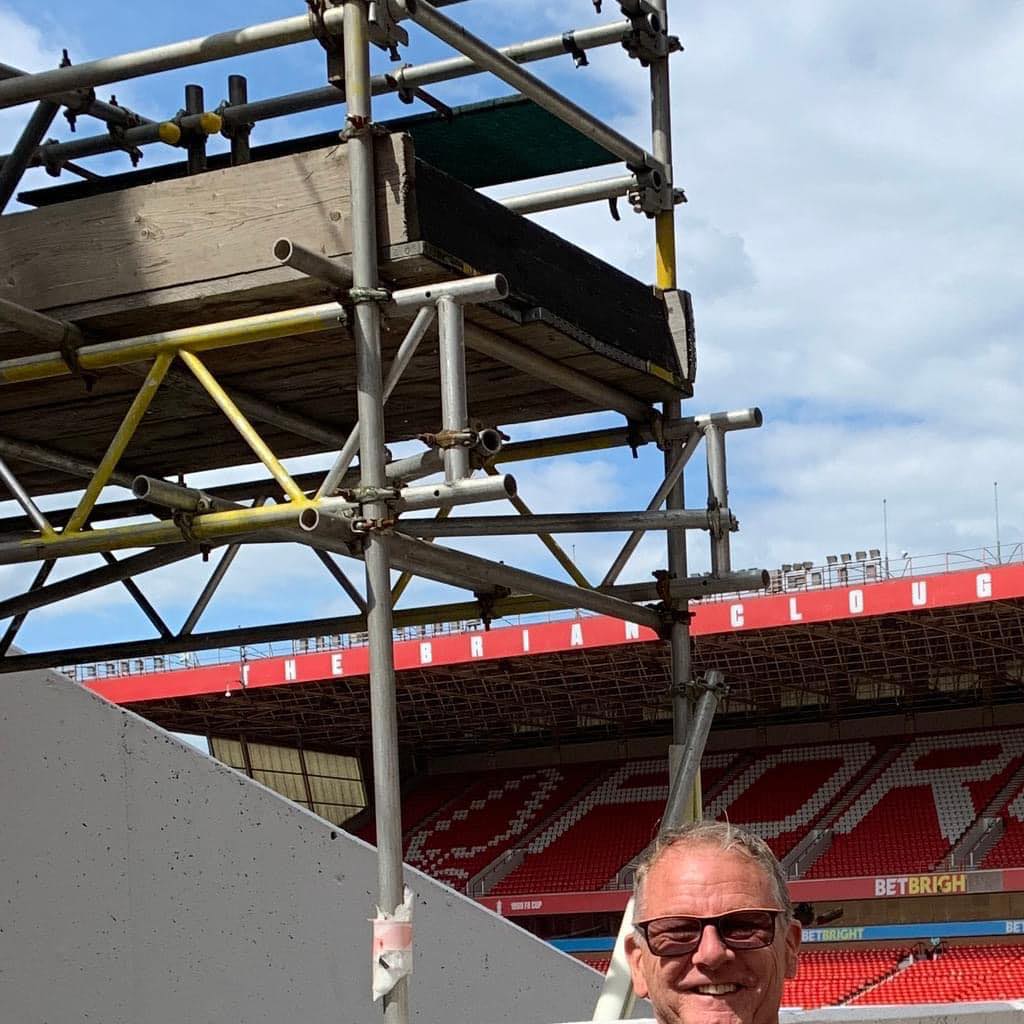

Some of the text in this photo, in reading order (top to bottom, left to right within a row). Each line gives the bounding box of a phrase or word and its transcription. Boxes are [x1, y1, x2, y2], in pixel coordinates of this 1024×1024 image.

[240, 653, 344, 688] THE
[420, 620, 640, 665] BRIAN
[874, 874, 967, 896] BETBRIGH
[801, 926, 865, 943] BETBRIGHT
